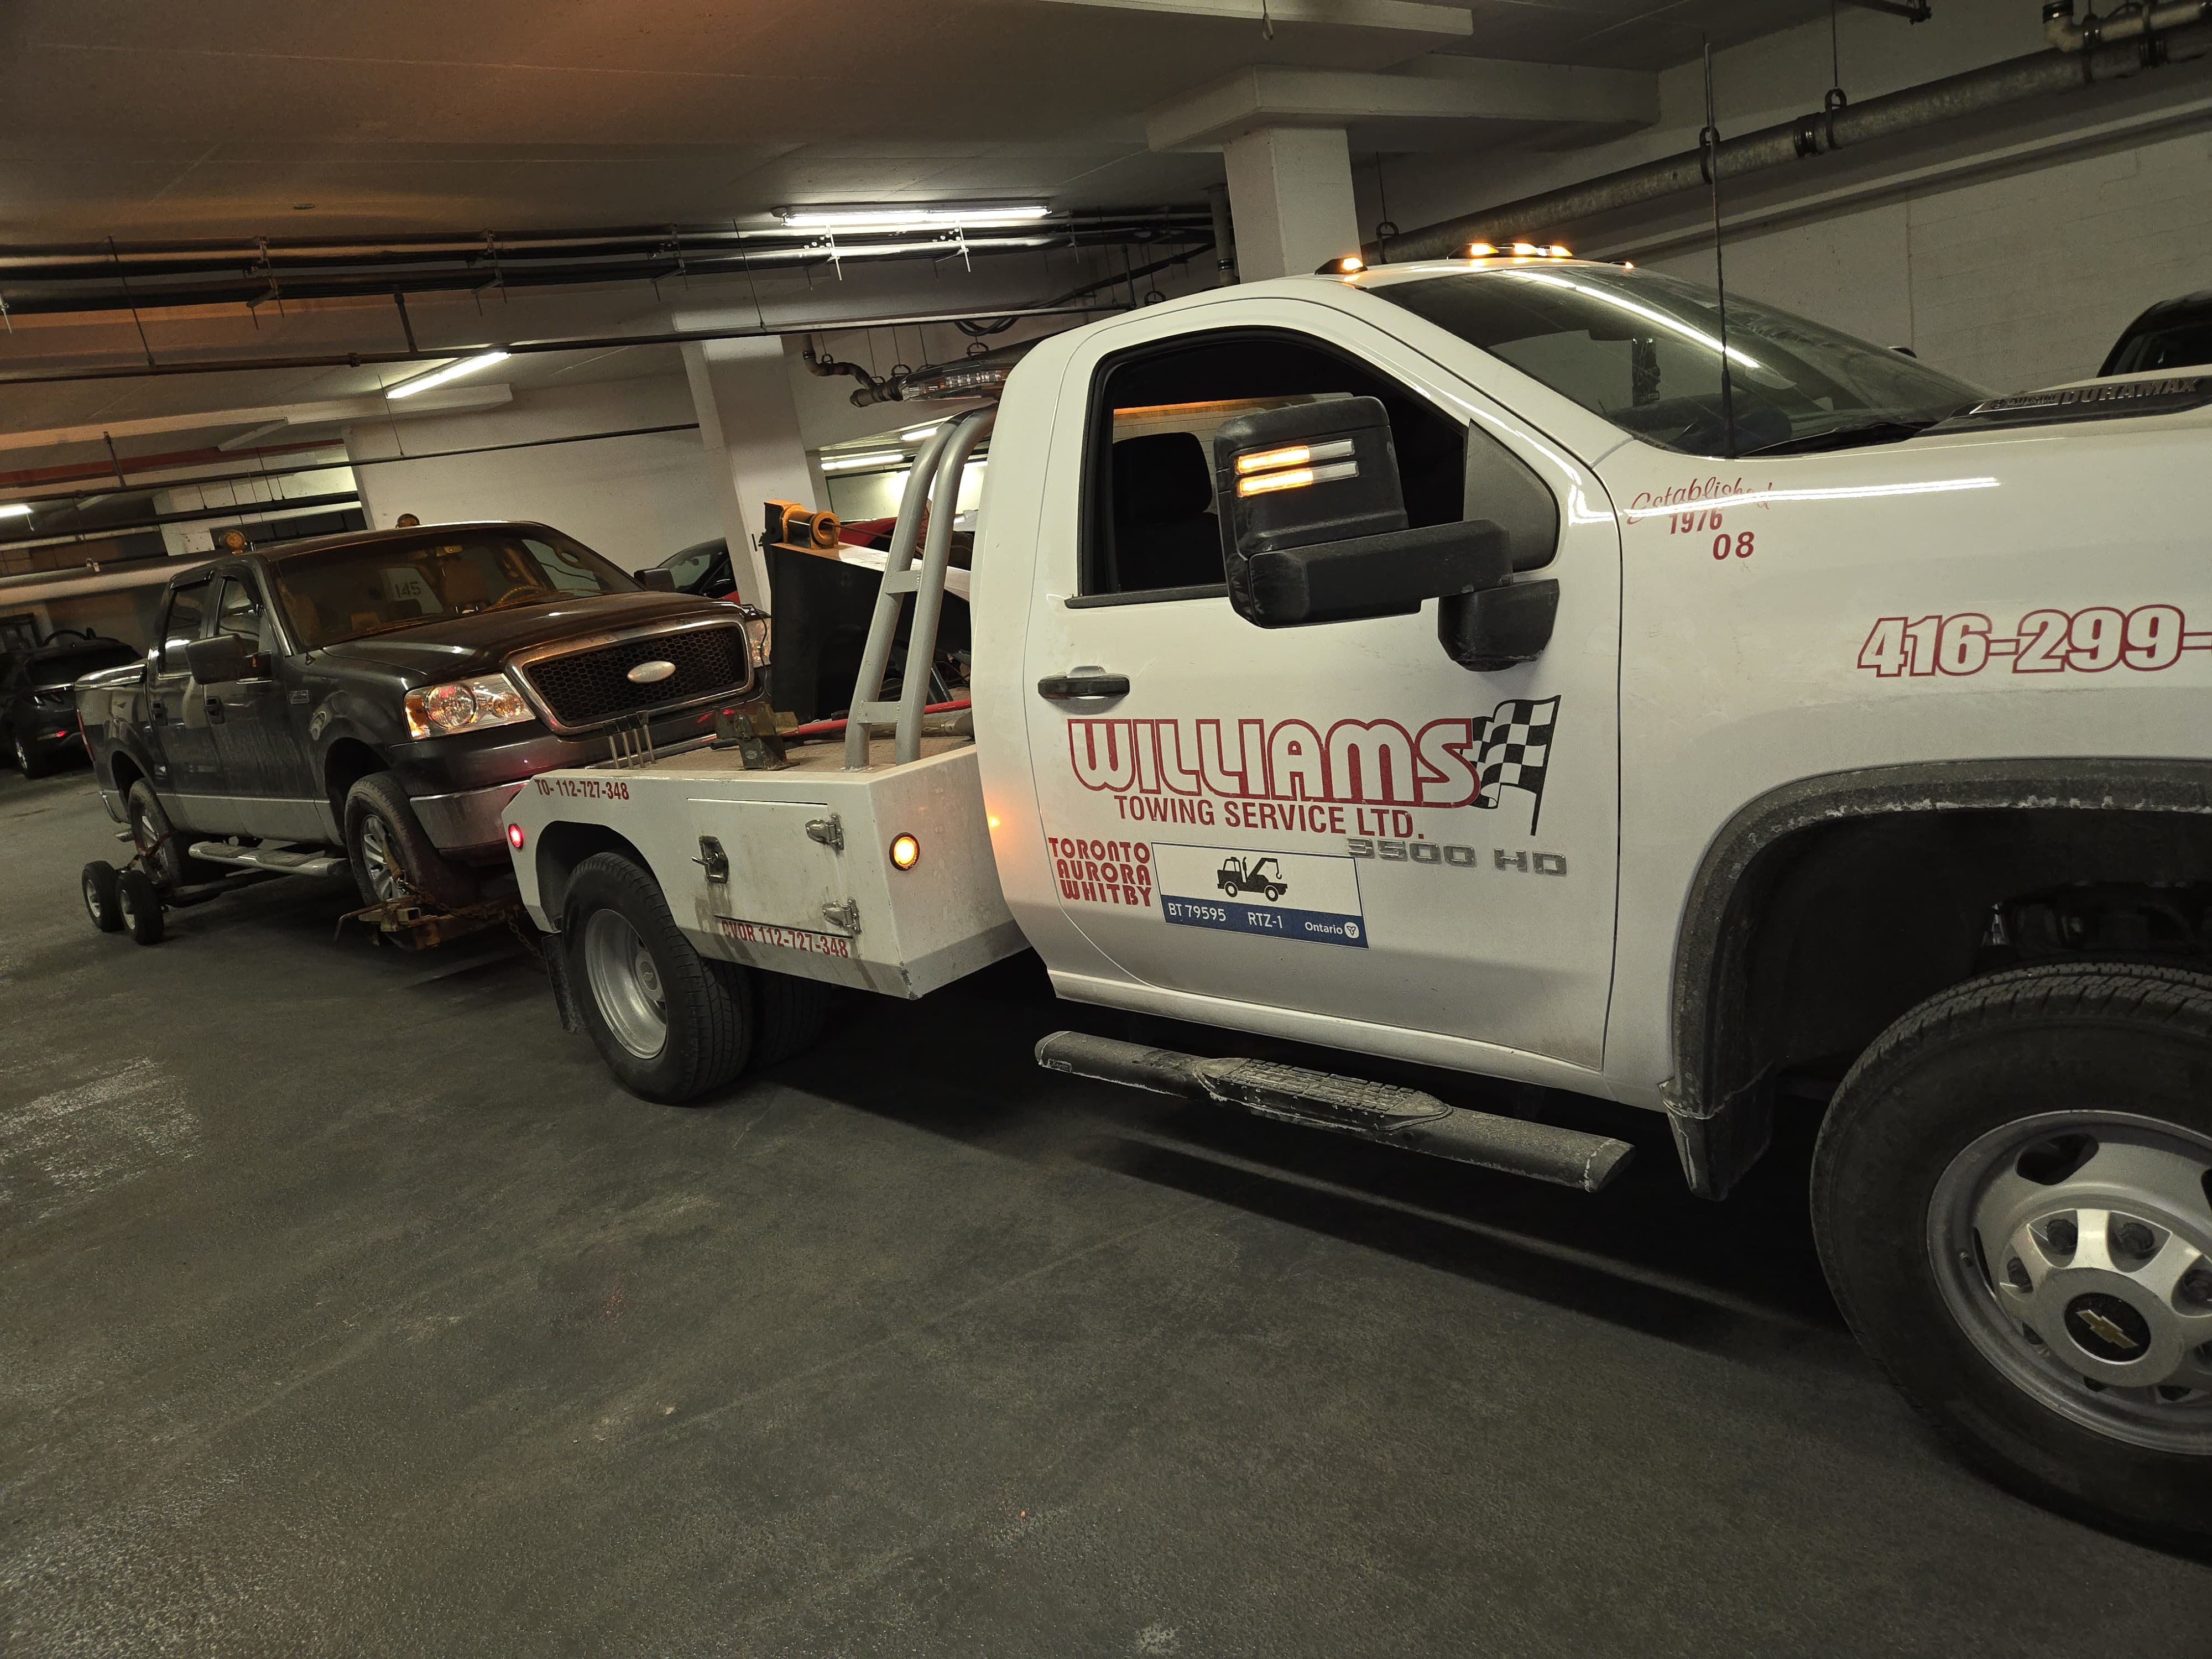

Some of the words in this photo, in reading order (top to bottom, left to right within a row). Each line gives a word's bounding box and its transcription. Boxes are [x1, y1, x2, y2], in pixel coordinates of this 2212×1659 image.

[2059, 378, 2199, 406] DURAMAX
[1668, 507, 1724, 535] 1976
[1713, 531, 1755, 561] 08
[395, 581, 421, 598] 145
[1068, 718, 1481, 808] WILLIAMS
[556, 779, 629, 800] 112-727-348
[1114, 795, 1215, 826] TOWING
[1224, 800, 1347, 835] SERVICE
[1357, 807, 1425, 839] LTD.
[1048, 837, 1150, 864] TORONTO
[1347, 837, 1476, 868] 3500
[1494, 848, 1567, 876] HD
[1057, 859, 1151, 885] AURORA
[1060, 879, 1152, 907] WHITBY
[1167, 902, 1182, 916] BT
[1185, 904, 1227, 922] 79595
[1247, 912, 1284, 929] RTZ-1
[1305, 921, 1343, 935] Ontario
[722, 920, 757, 943] CVOR
[758, 926, 849, 958] 112-727-348
